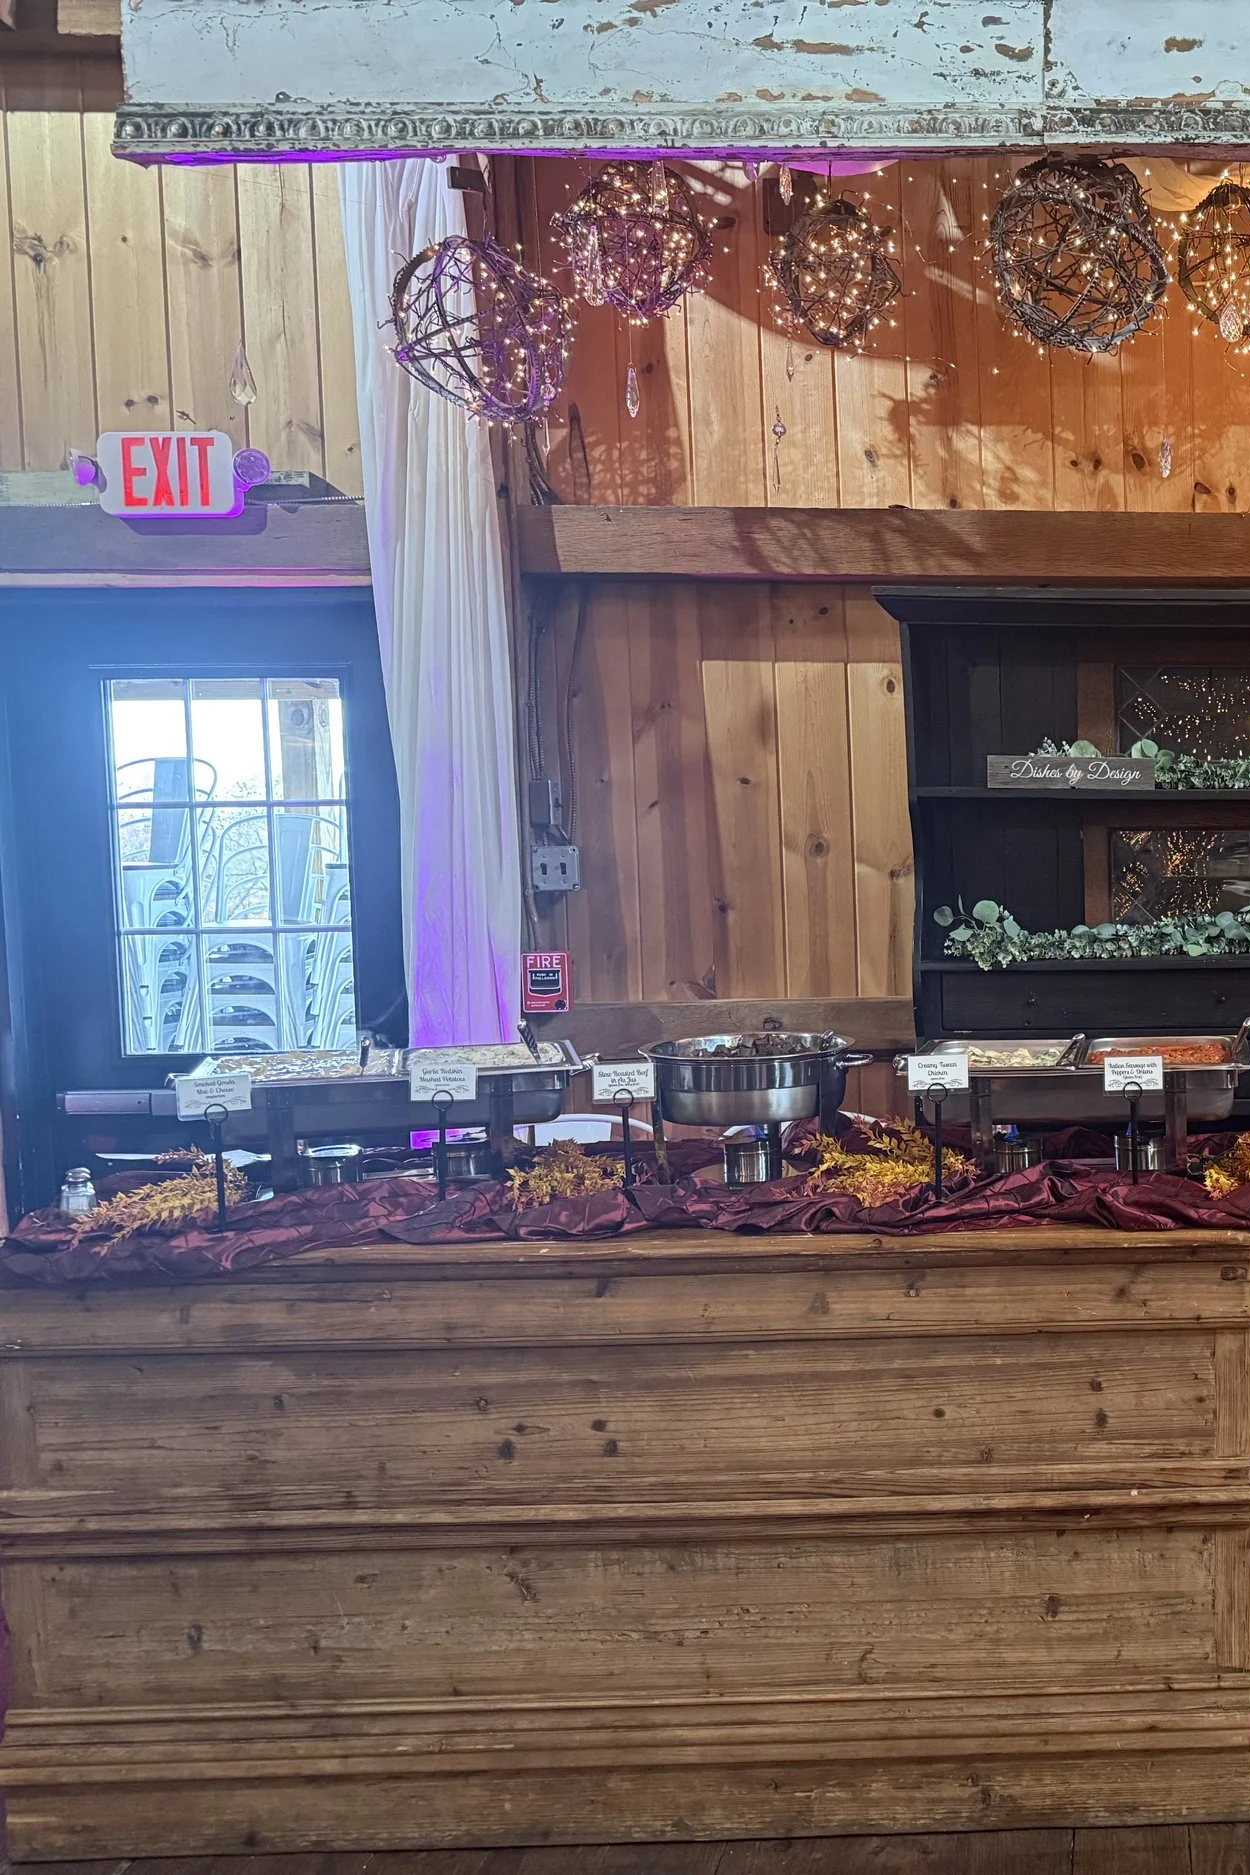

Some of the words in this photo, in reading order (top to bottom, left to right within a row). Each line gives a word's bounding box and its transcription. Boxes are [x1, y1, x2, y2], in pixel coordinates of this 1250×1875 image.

[121, 437, 215, 507] EXIT
[1010, 759, 1062, 779] Dishes
[1065, 763, 1083, 784] by
[1087, 761, 1141, 785] Design
[526, 955, 562, 968] FIRE
[636, 1069, 649, 1077] Beef
